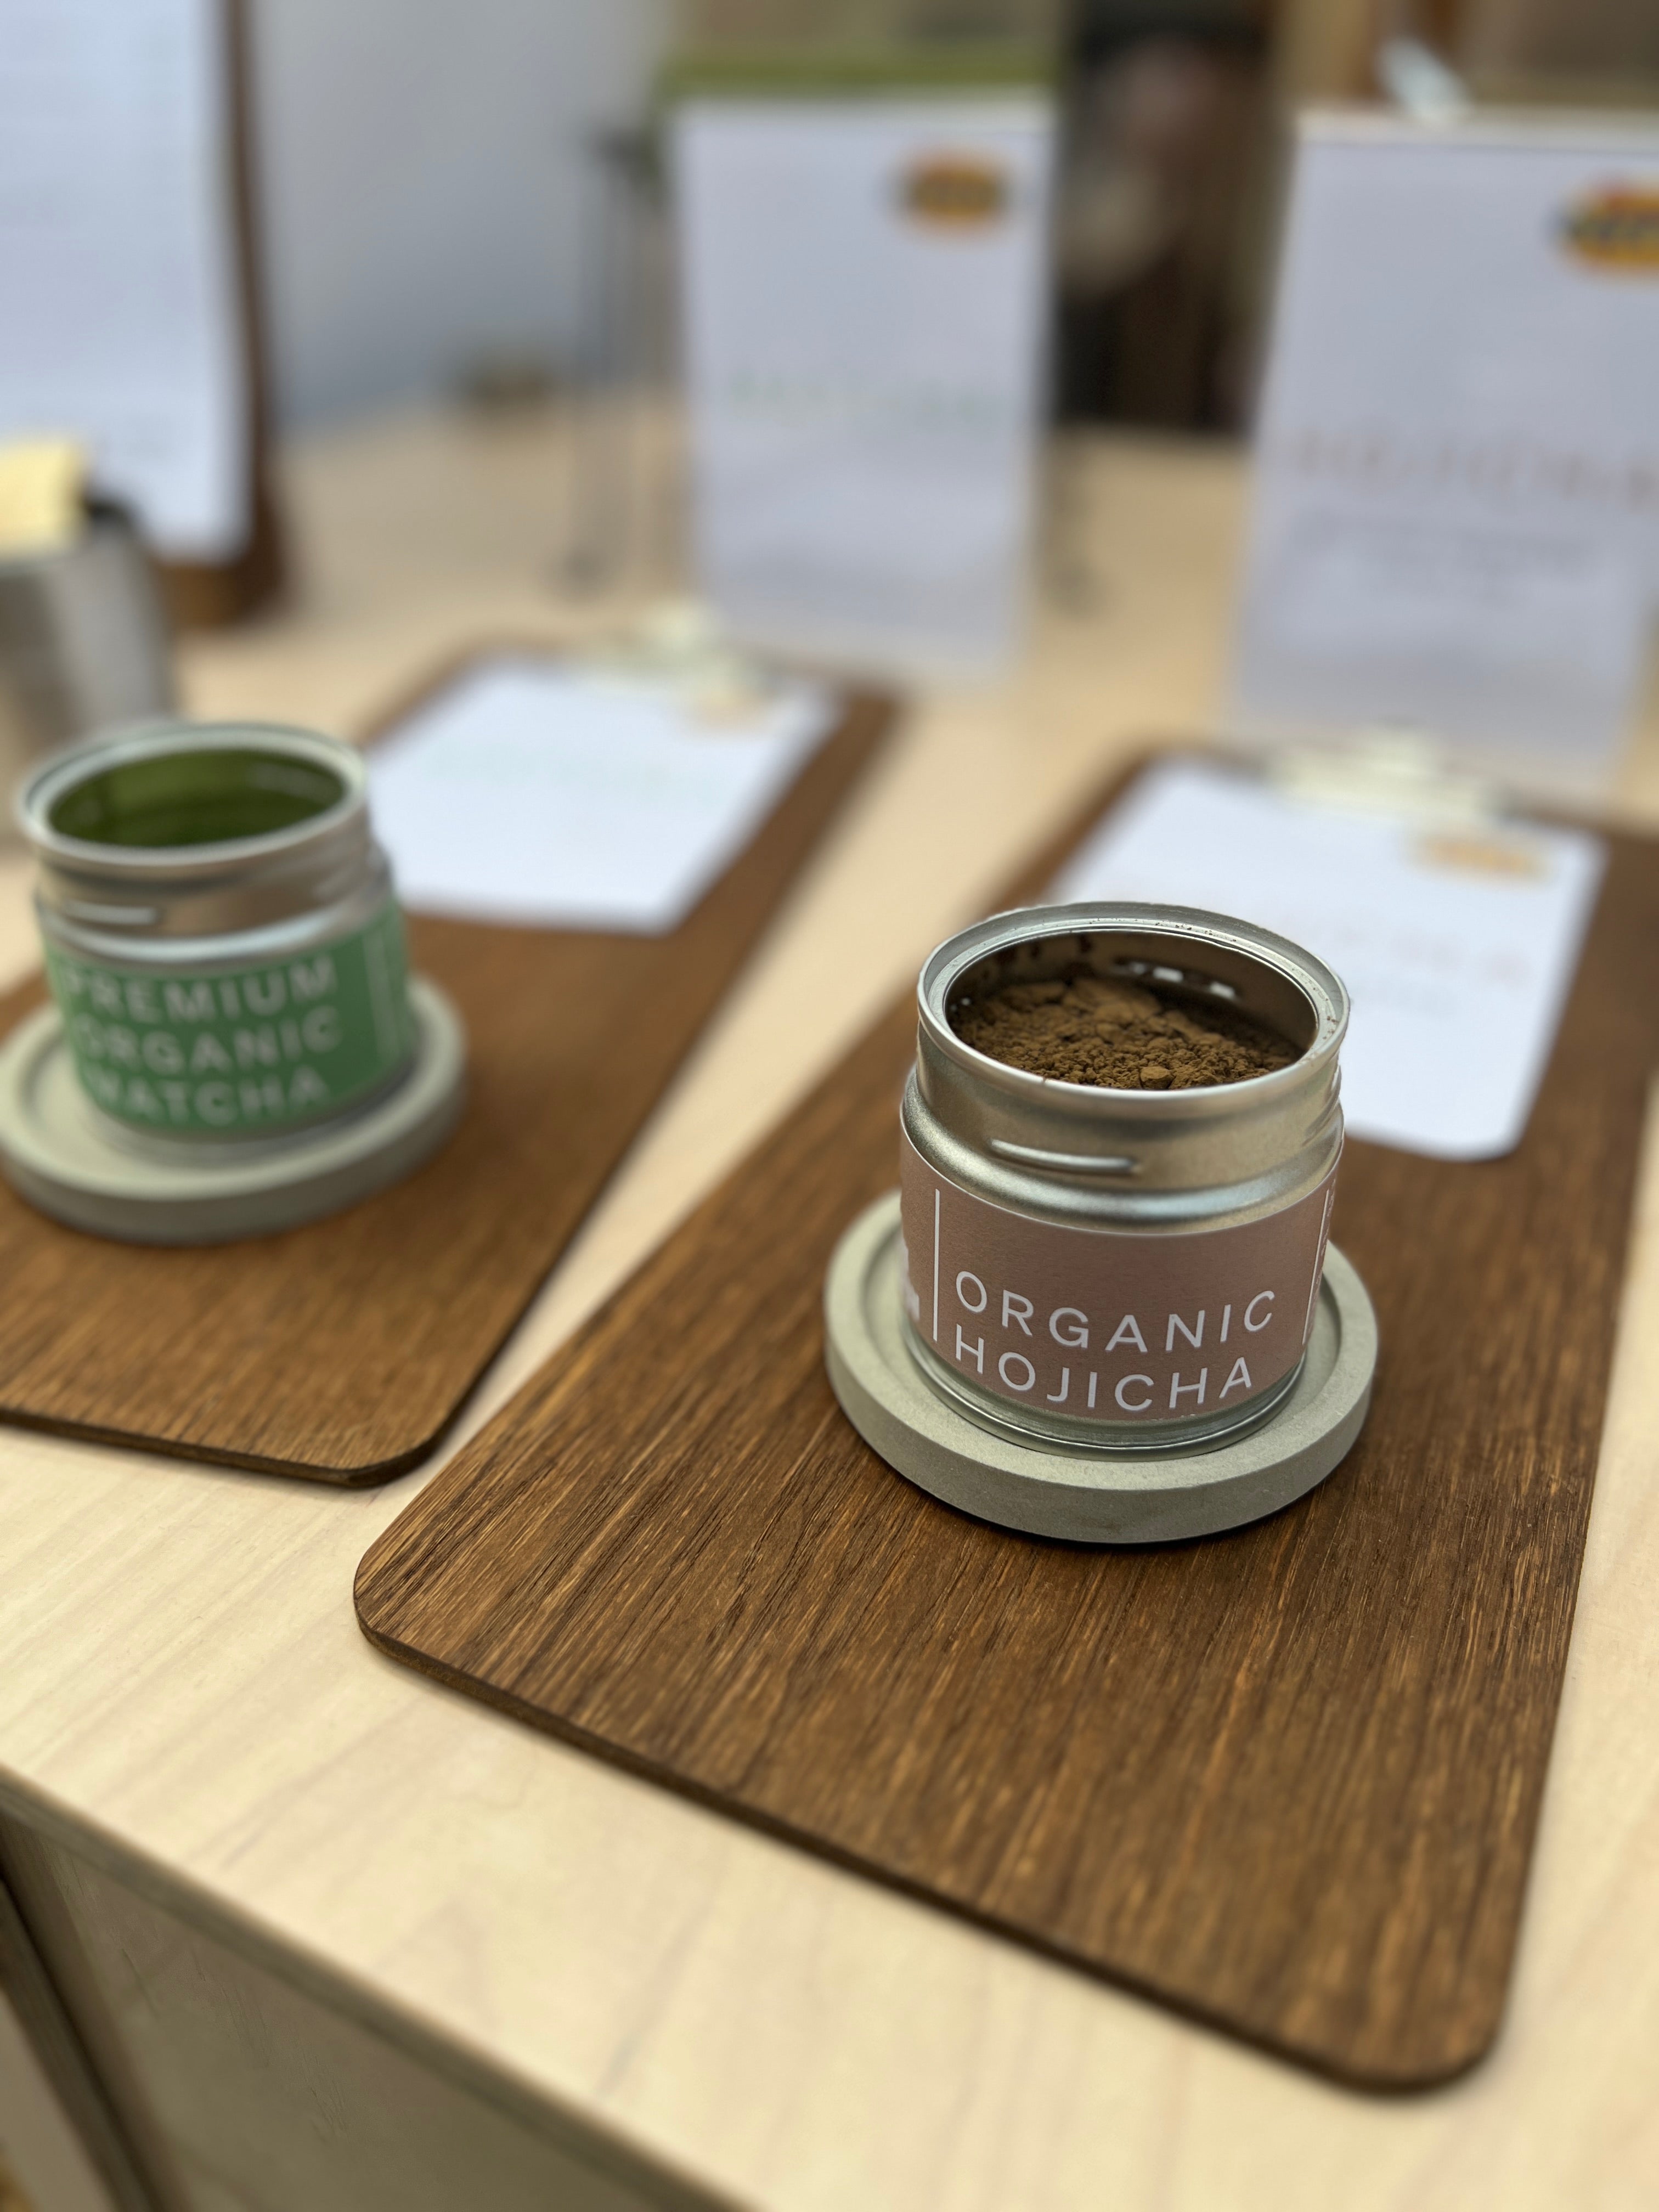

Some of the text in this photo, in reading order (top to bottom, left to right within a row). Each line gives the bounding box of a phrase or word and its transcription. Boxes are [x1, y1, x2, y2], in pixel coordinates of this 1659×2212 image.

[63, 956, 335, 1022] PREMIUM
[74, 1006, 340, 1073] ORGANIC
[956, 1271, 1275, 1352] ORGANIC
[956, 1325, 1252, 1412] HOJICHA
